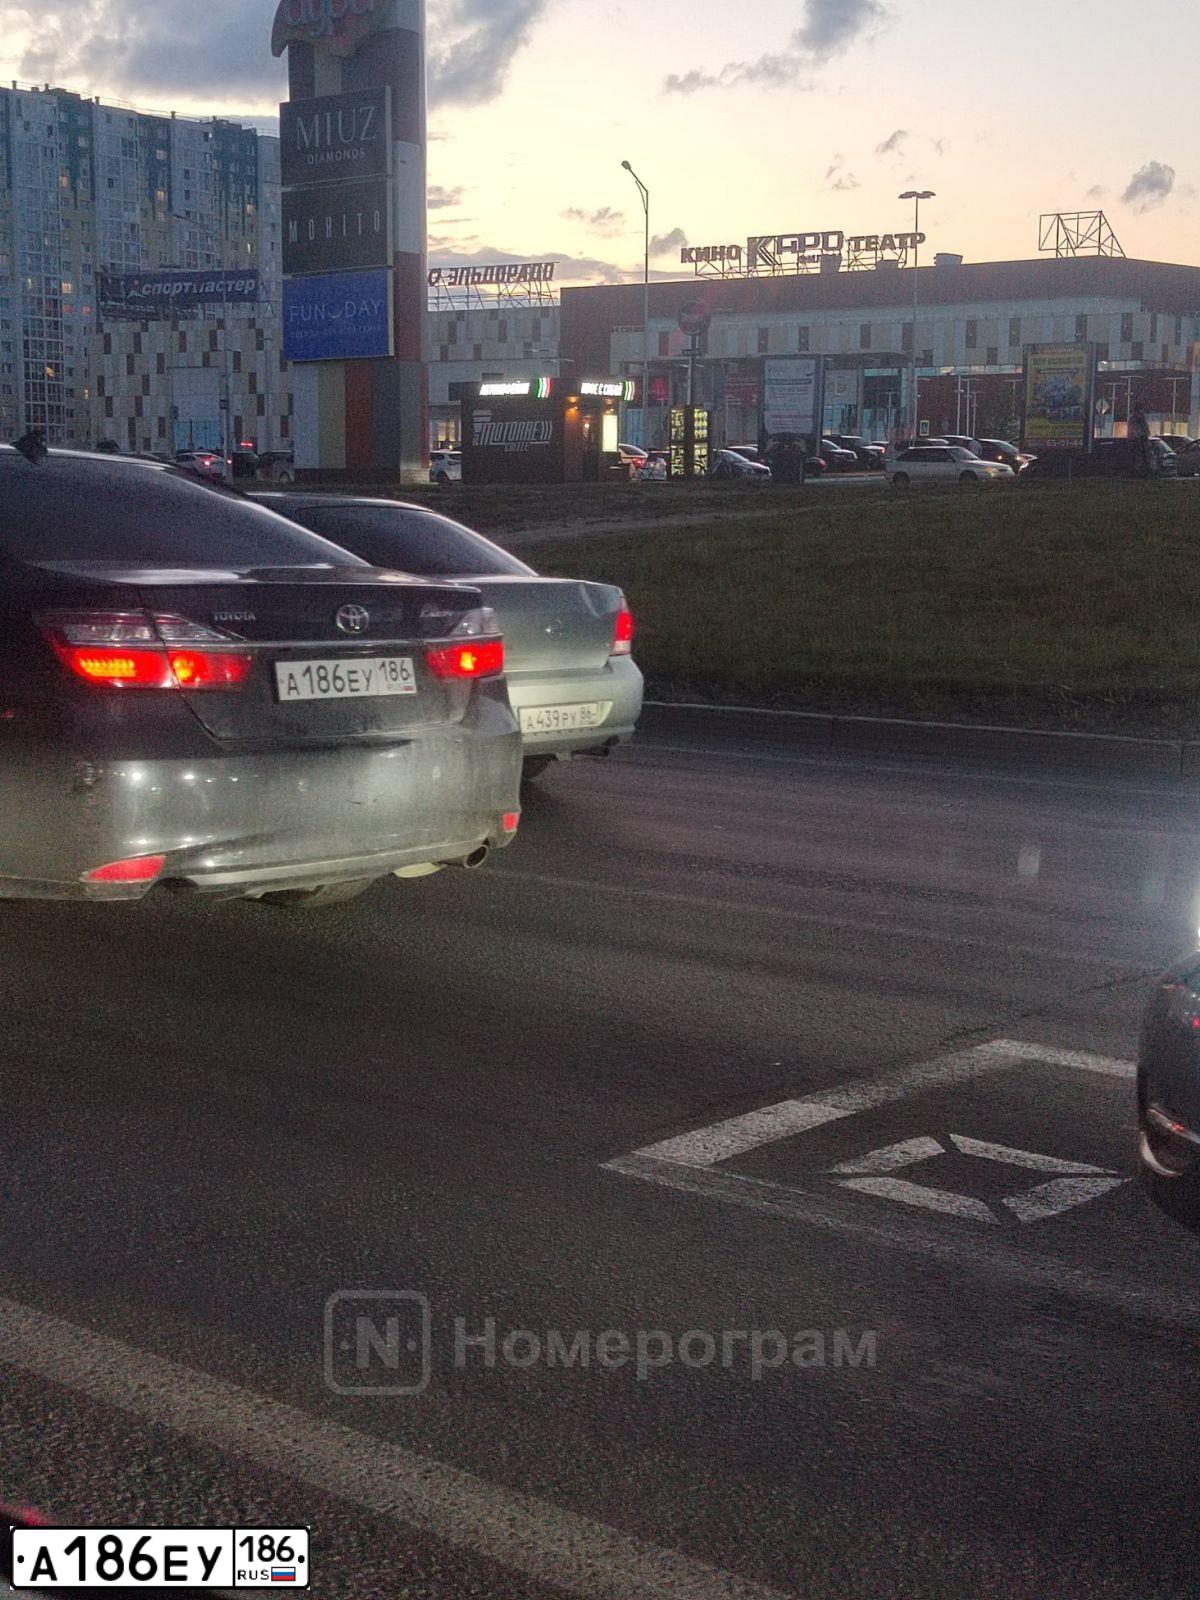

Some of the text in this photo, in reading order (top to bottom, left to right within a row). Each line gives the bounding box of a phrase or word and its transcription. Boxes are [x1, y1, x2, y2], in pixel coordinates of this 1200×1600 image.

[297, 105, 376, 150] MIUZ
[307, 148, 366, 165] DIAMONDS
[288, 209, 381, 244] MOHITO
[681, 245, 742, 264] КИНО
[851, 232, 926, 253] ТЕАТР
[289, 299, 382, 322] FUN DAY
[214, 612, 256, 621] TOYOTA
